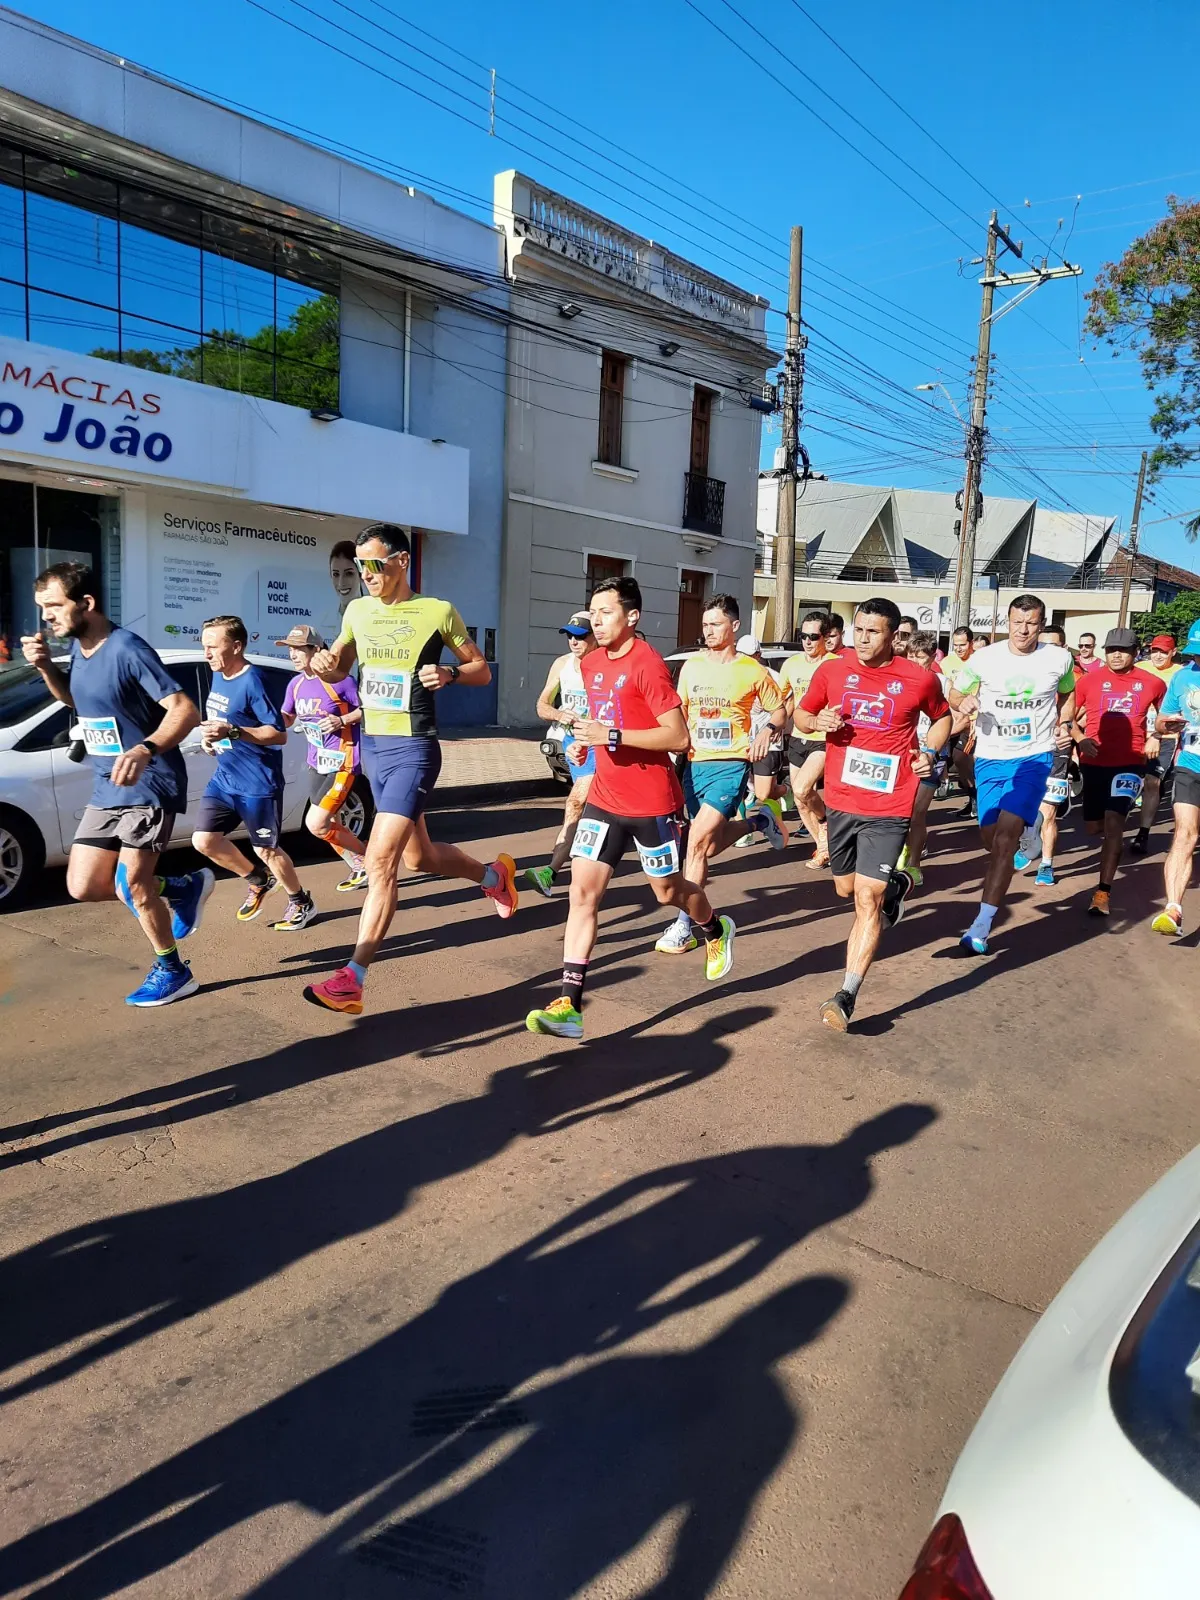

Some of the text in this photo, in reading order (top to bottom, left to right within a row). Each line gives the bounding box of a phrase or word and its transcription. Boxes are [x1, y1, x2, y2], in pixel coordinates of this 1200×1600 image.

[3, 362, 161, 414] MÁCIAS
[0, 402, 173, 462] o João
[164, 512, 317, 547] Serviços Farmacêuticos
[196, 569, 222, 577] moderno
[267, 580, 287, 590] AQUI
[267, 593, 289, 602] VOCÊ
[267, 606, 312, 616] ENCONTRA:
[366, 648, 410, 660] CAVALOS
[370, 682, 399, 698] 207
[568, 695, 587, 707] 080
[699, 694, 731, 708] RÚSTICA
[1107, 697, 1133, 709] TAG
[849, 698, 885, 718] TAG
[851, 713, 881, 723] TARCISO
[1001, 725, 1028, 736] 009
[86, 730, 115, 744] 086
[321, 757, 340, 769] 005
[855, 761, 885, 780] 236
[1120, 780, 1139, 792] 238
[640, 853, 667, 869] 001
